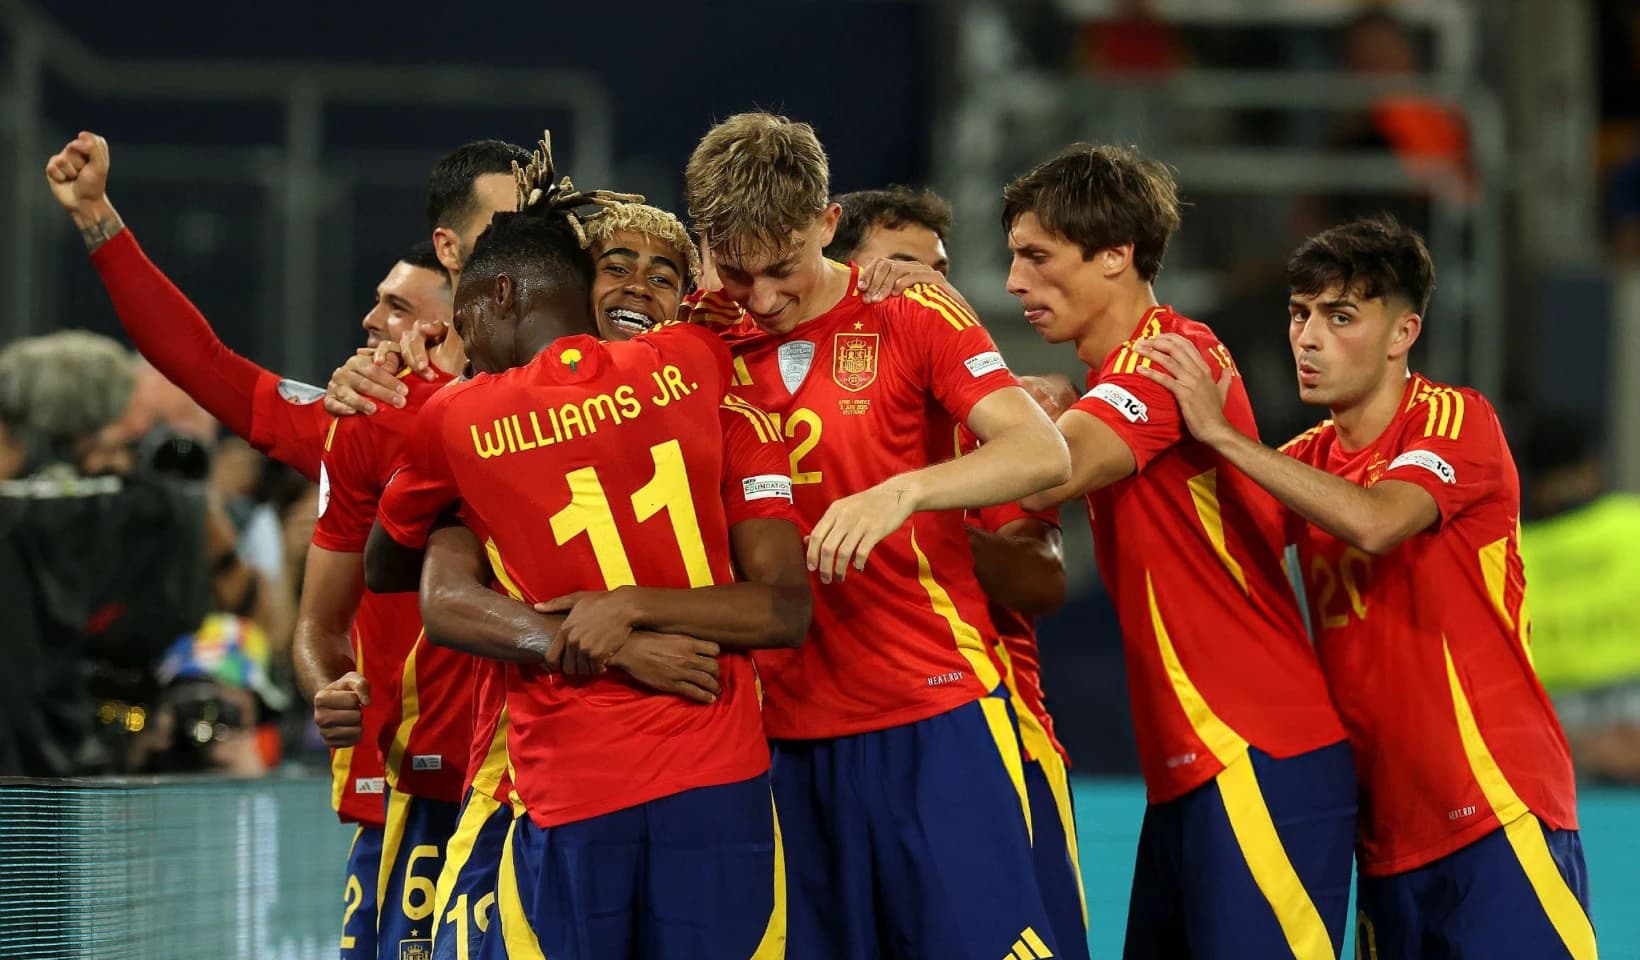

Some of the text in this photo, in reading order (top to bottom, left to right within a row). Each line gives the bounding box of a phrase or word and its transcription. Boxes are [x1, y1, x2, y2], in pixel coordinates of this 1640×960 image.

[470, 364, 699, 459] WILLIAMS JR.
[768, 408, 823, 485] 2
[549, 438, 716, 593] 11
[402, 845, 439, 921] 6
